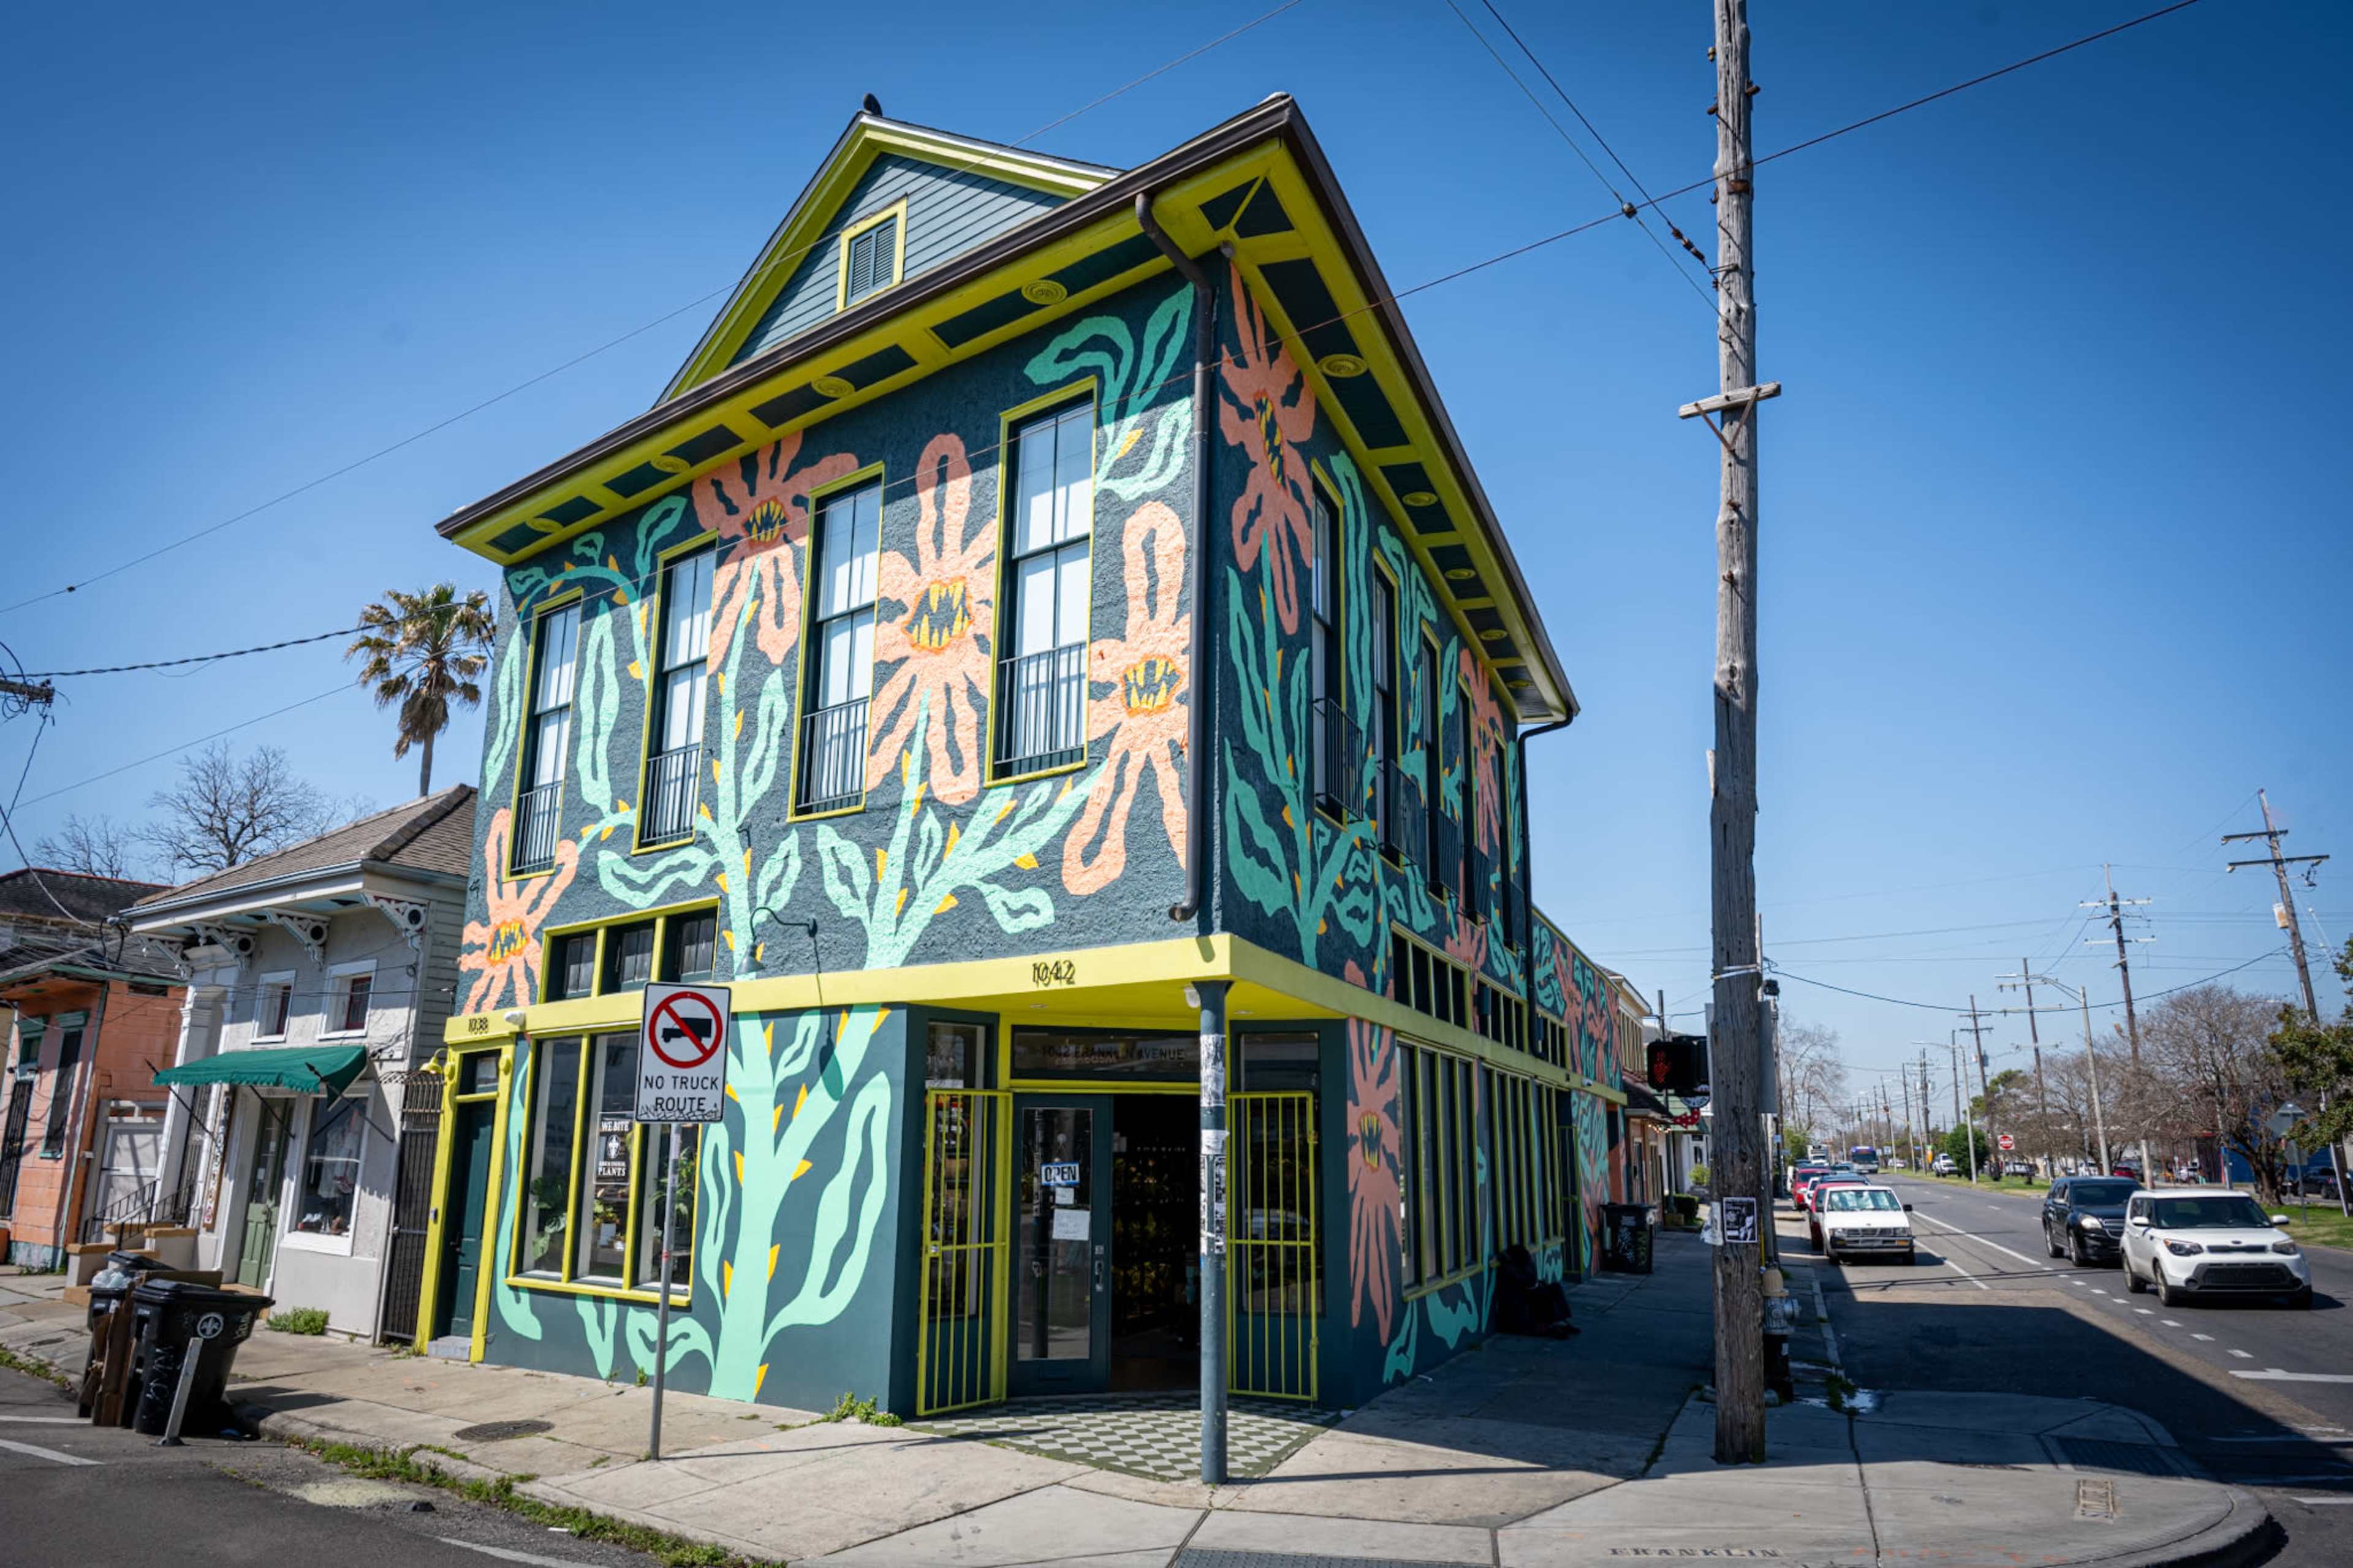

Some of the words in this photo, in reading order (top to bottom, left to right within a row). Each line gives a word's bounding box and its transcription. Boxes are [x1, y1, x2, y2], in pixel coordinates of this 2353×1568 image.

[1032, 960, 1076, 985] 1042
[1074, 1045, 1134, 1059] FRANKLN
[1138, 1047, 1185, 1060] AVENUE
[644, 1075, 664, 1089] NO
[672, 1075, 719, 1090] TRUCK
[654, 1097, 707, 1112] ROUTE
[602, 1121, 612, 1131] WE
[613, 1121, 629, 1132] BITE
[598, 1166, 626, 1177] PLANTS
[1045, 1165, 1077, 1182] OPEN
[1608, 1547, 1779, 1557] FRANKLIN
